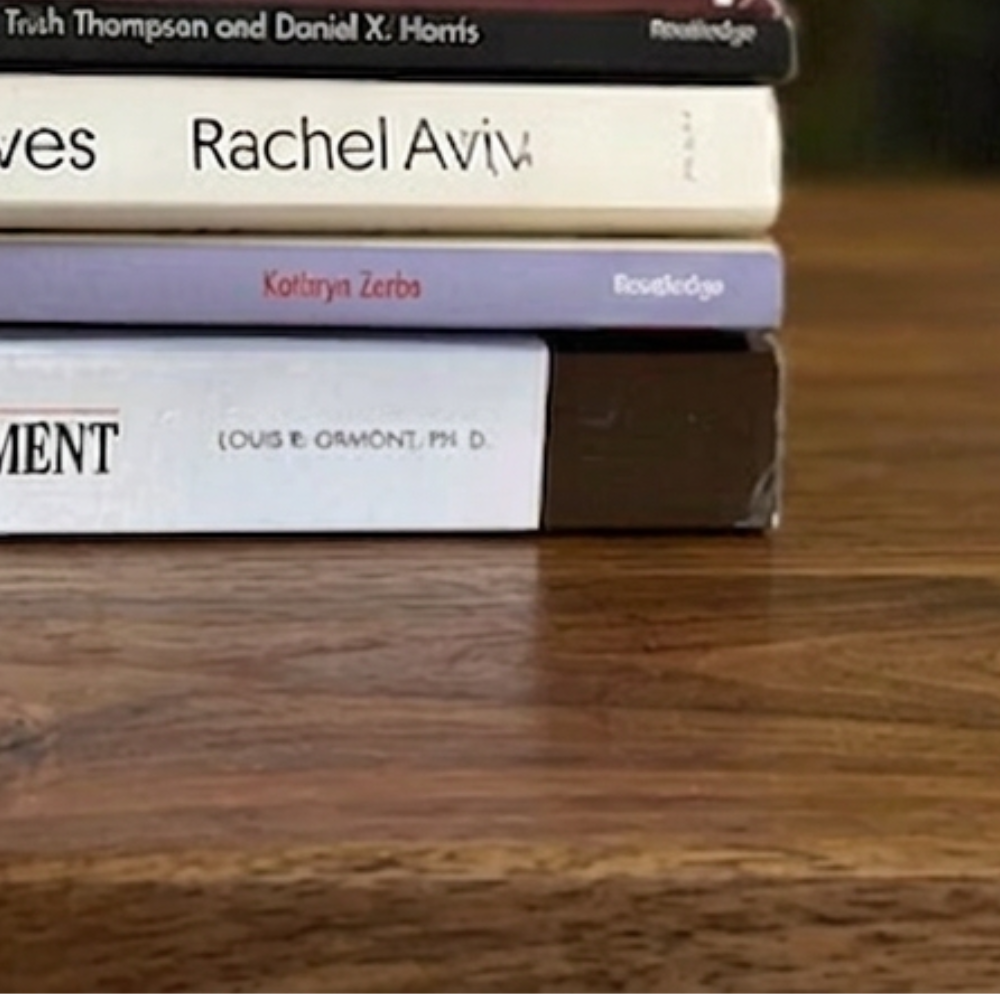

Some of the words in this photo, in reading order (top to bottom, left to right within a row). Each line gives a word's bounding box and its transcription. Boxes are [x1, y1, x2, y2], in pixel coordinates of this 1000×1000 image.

[73, 9, 209, 43] Thompson
[215, 11, 267, 39] and
[275, 13, 358, 41] Daniel
[364, 14, 392, 41] X.
[192, 116, 389, 171] Rachel
[404, 117, 534, 175] Aviv
